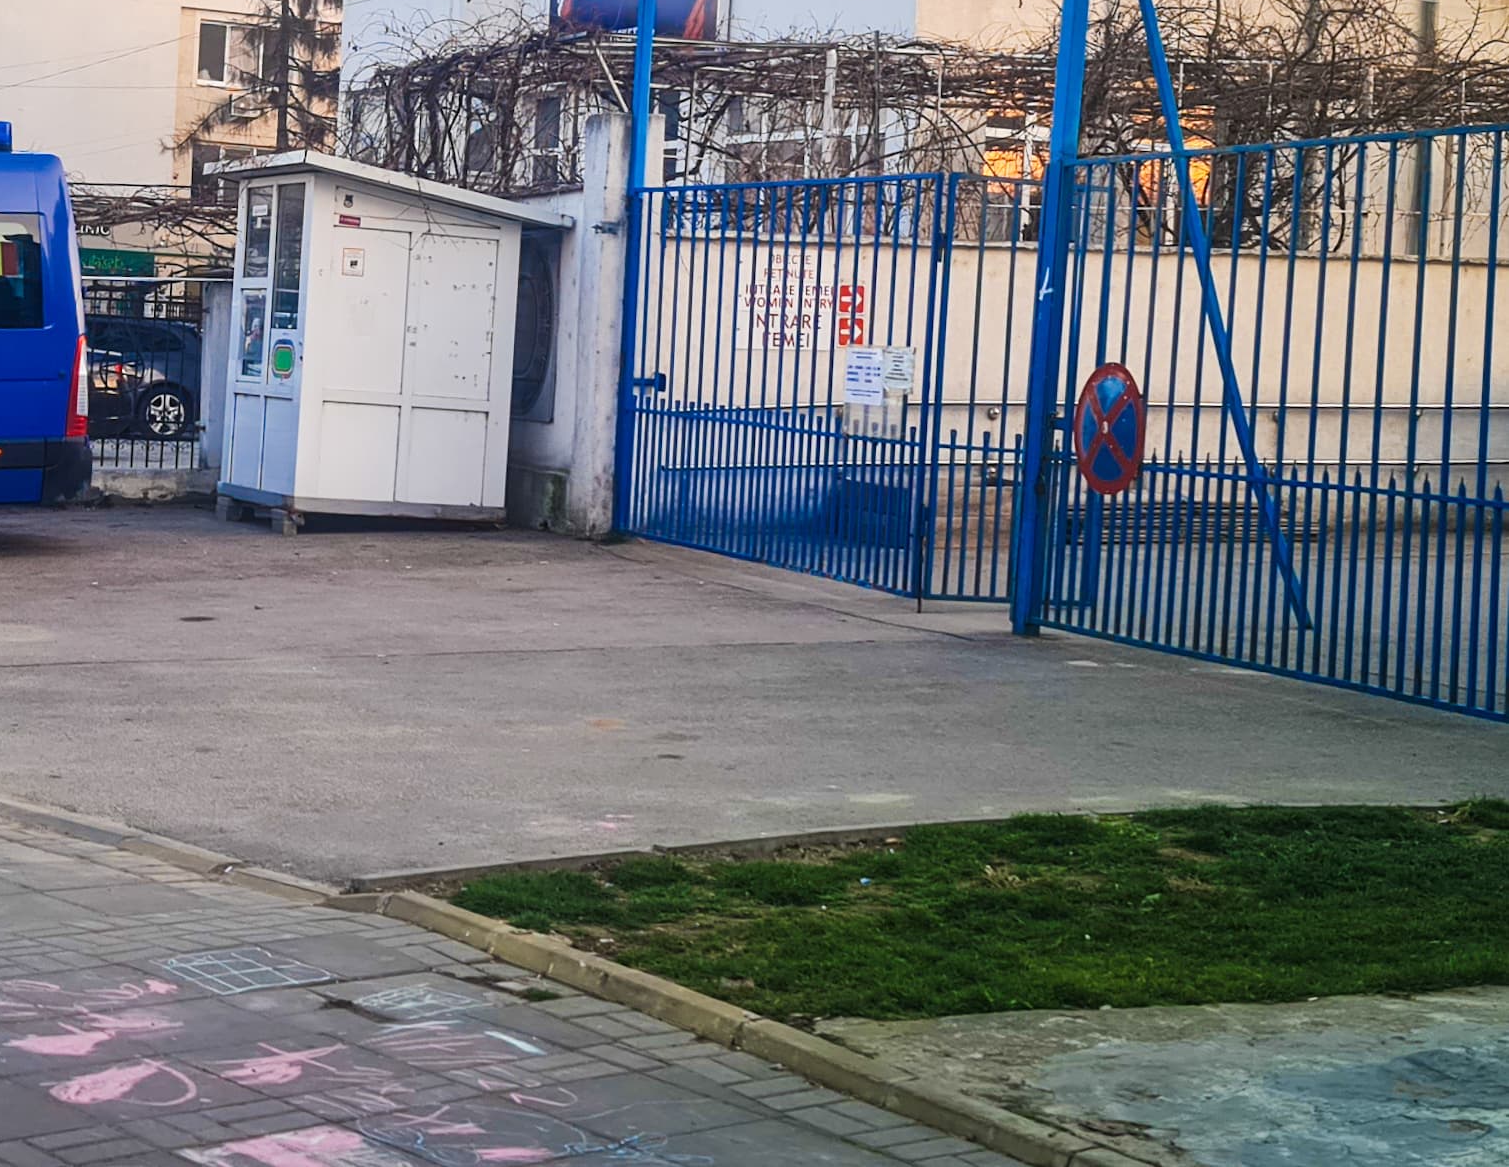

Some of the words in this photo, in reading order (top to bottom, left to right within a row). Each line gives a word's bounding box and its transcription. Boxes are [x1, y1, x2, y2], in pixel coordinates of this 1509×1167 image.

[744, 297, 794, 308] WOMN
[754, 313, 822, 330] NTRAR
[763, 332, 810, 348] EMEI
